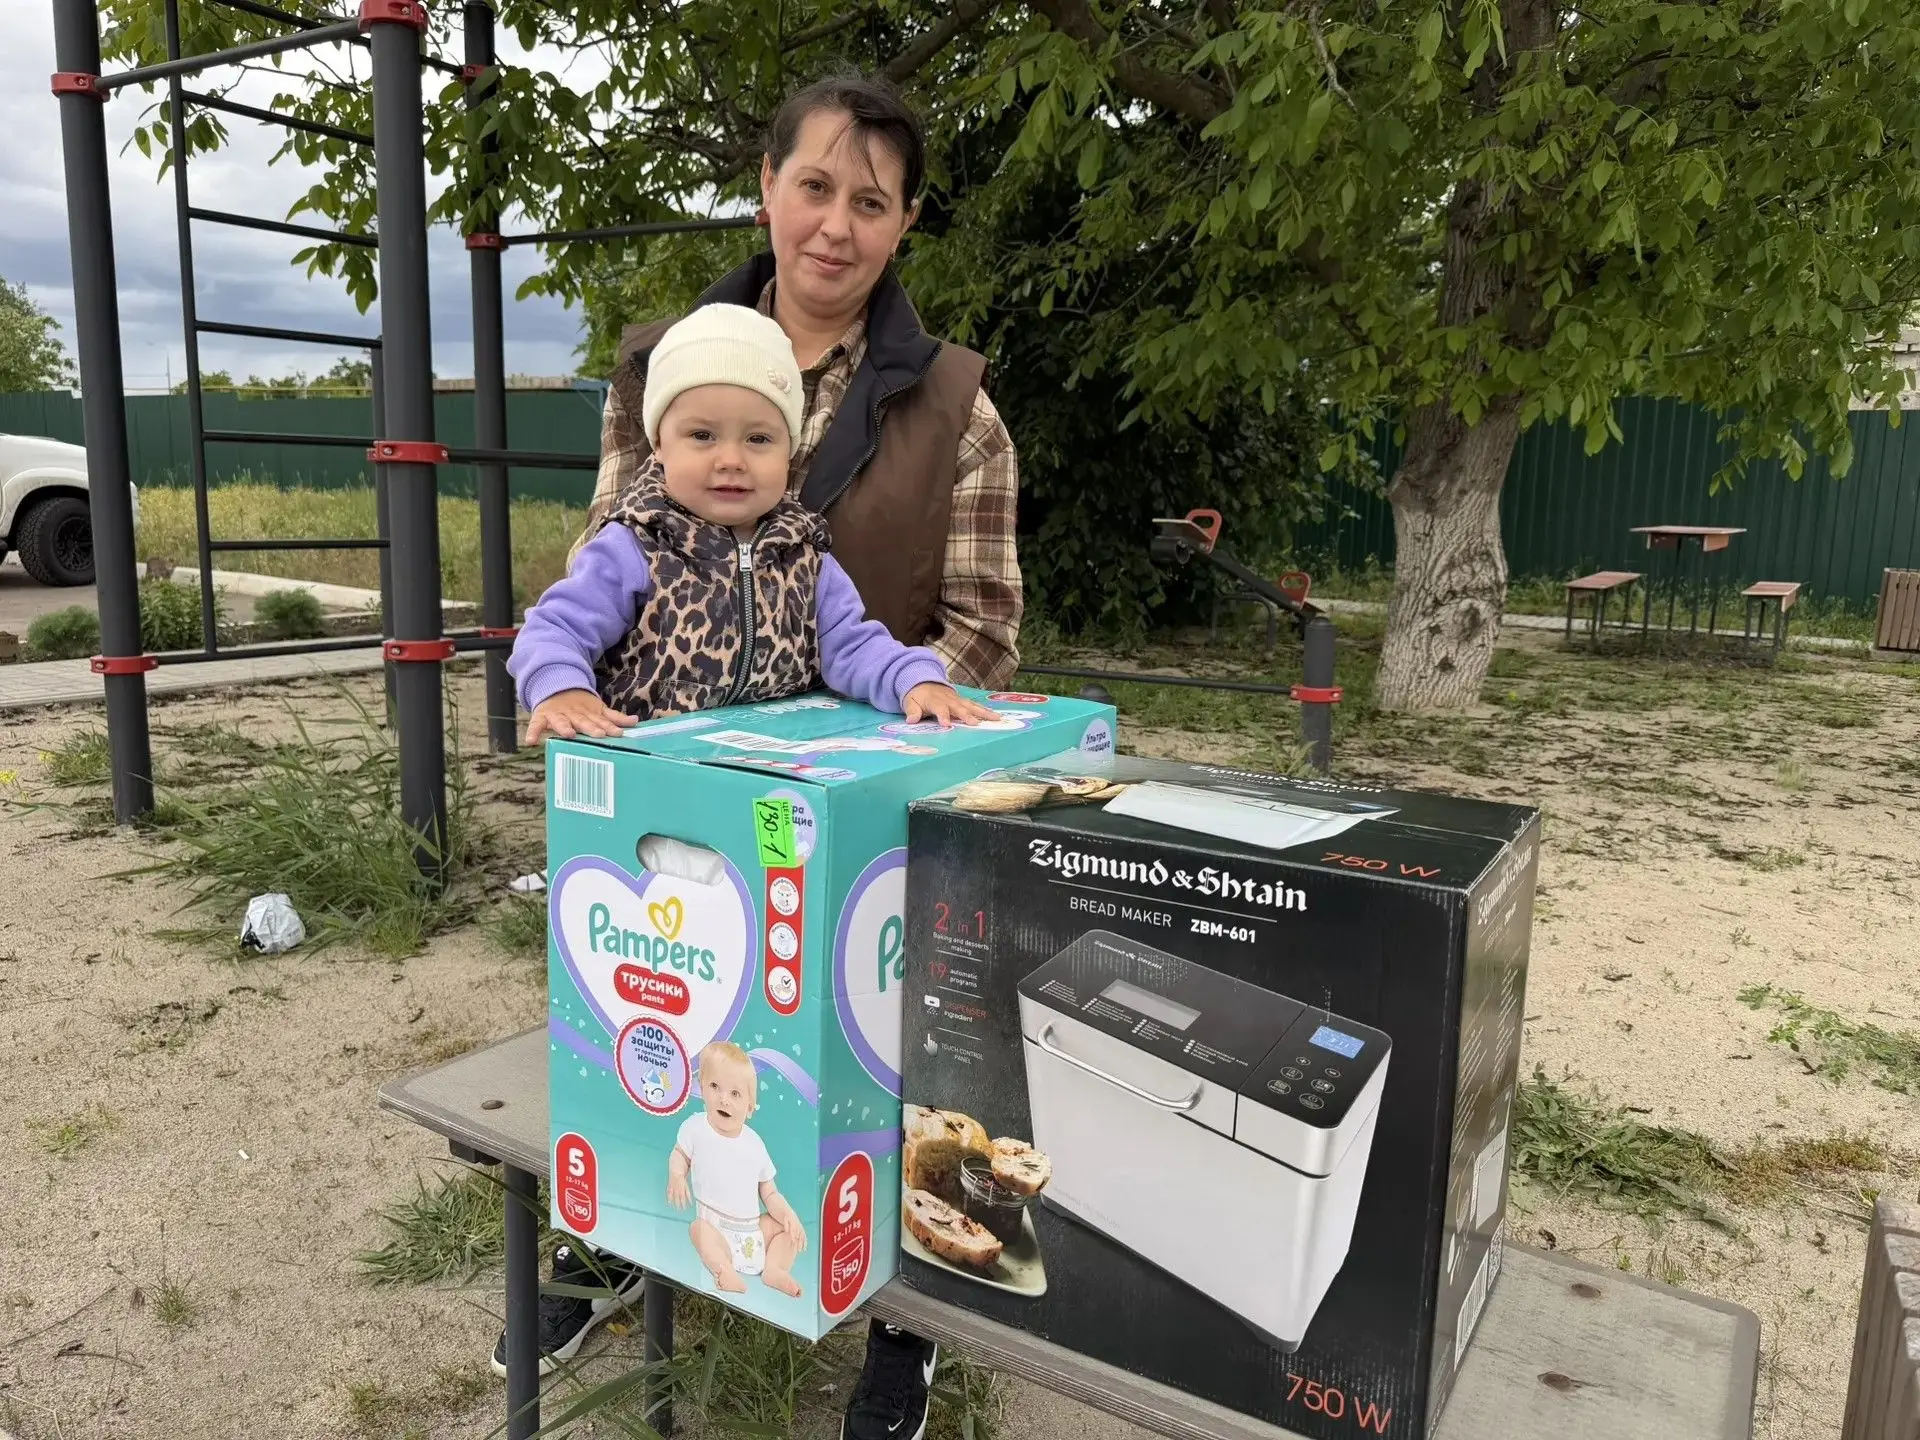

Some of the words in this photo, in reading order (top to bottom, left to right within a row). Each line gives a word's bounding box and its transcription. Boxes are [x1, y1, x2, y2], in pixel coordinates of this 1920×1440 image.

[782, 801, 790, 826] ЦЕНА
[1028, 838, 1169, 886] Zigmund
[1195, 866, 1308, 912] Shtain
[1320, 852, 1388, 871] 750
[1400, 863, 1441, 877] W
[934, 902, 950, 932] 2
[957, 919, 970, 936] in
[974, 910, 986, 938] 1
[1069, 896, 1117, 917] BREAD
[1121, 907, 1172, 928] MAKER
[1190, 918, 1257, 944] ZBM-601
[588, 902, 716, 981] Pampers
[932, 931, 953, 944] Baking
[953, 937, 964, 945] and
[964, 939, 990, 951] desserts
[950, 945, 973, 956] making
[620, 971, 684, 999] трусики
[949, 968, 978, 980] automatic
[949, 976, 978, 988] programs
[641, 993, 665, 1005] pants
[631, 1036, 675, 1056] защиты
[637, 1054, 668, 1069] ночью
[568, 1147, 585, 1177] 5
[838, 1174, 858, 1224] 5
[842, 1258, 859, 1281] 150
[1286, 1372, 1345, 1418] 750
[1354, 1396, 1393, 1434] W
